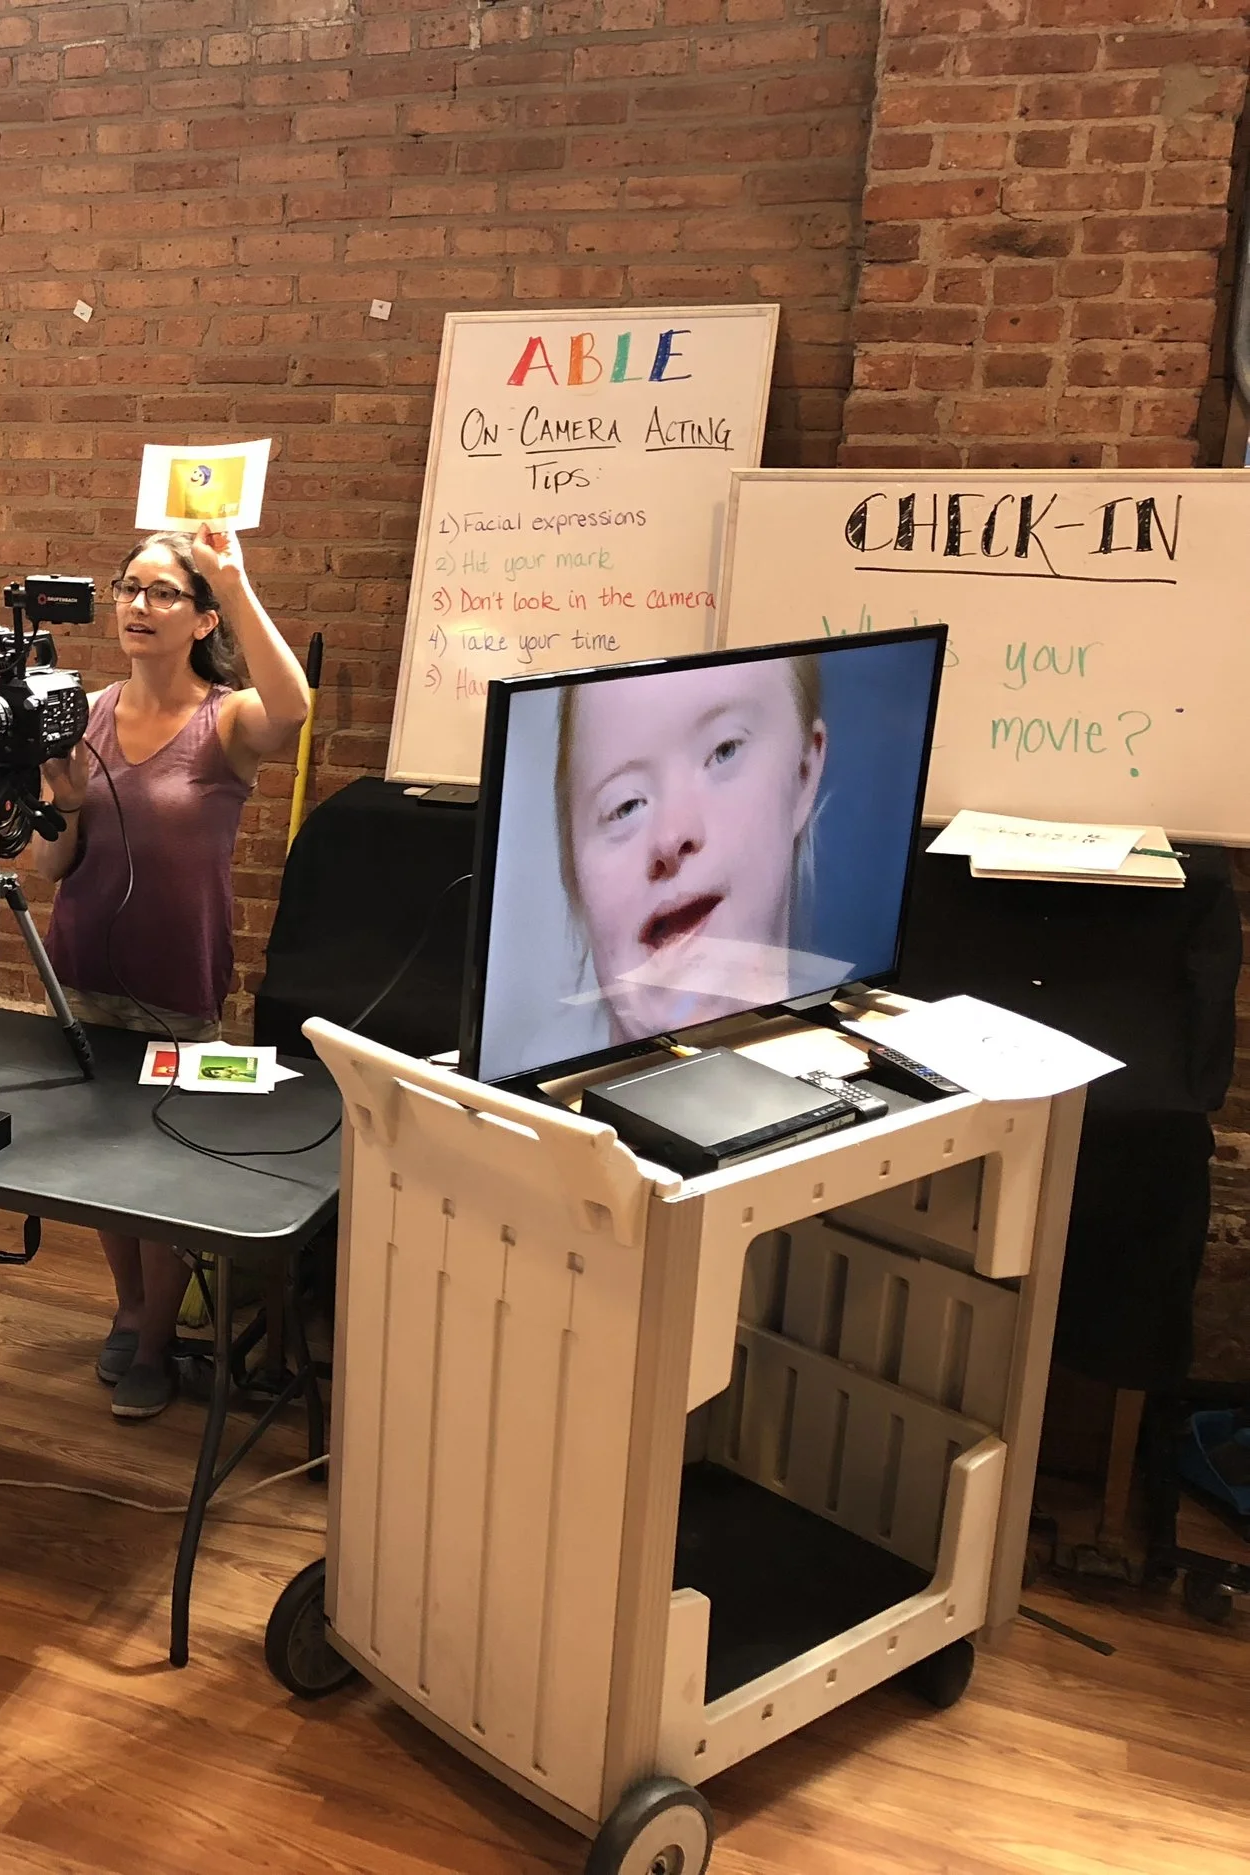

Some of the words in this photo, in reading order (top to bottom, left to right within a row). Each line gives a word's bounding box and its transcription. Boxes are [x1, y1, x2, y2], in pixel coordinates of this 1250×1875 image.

[507, 329, 692, 386] ABLE
[645, 405, 736, 451] ACTING
[438, 512, 460, 544] 1)
[464, 511, 521, 532] Facial
[531, 509, 647, 535] expressions
[844, 492, 1183, 577] CHECK-IN
[435, 550, 456, 576] 2)
[462, 551, 490, 574] Hit
[504, 553, 546, 582] your
[556, 548, 614, 571] mark
[432, 586, 451, 616] 3)
[460, 587, 503, 613] Don't
[513, 591, 560, 612] look
[568, 589, 587, 610] in
[597, 586, 635, 609] the
[646, 588, 717, 610] camera
[428, 624, 448, 657] 4)
[459, 627, 509, 652] Take
[517, 633, 561, 664] your
[571, 629, 621, 652] time
[424, 664, 443, 695] 5)
[455, 666, 488, 700] Hav
[1002, 641, 1105, 690] your
